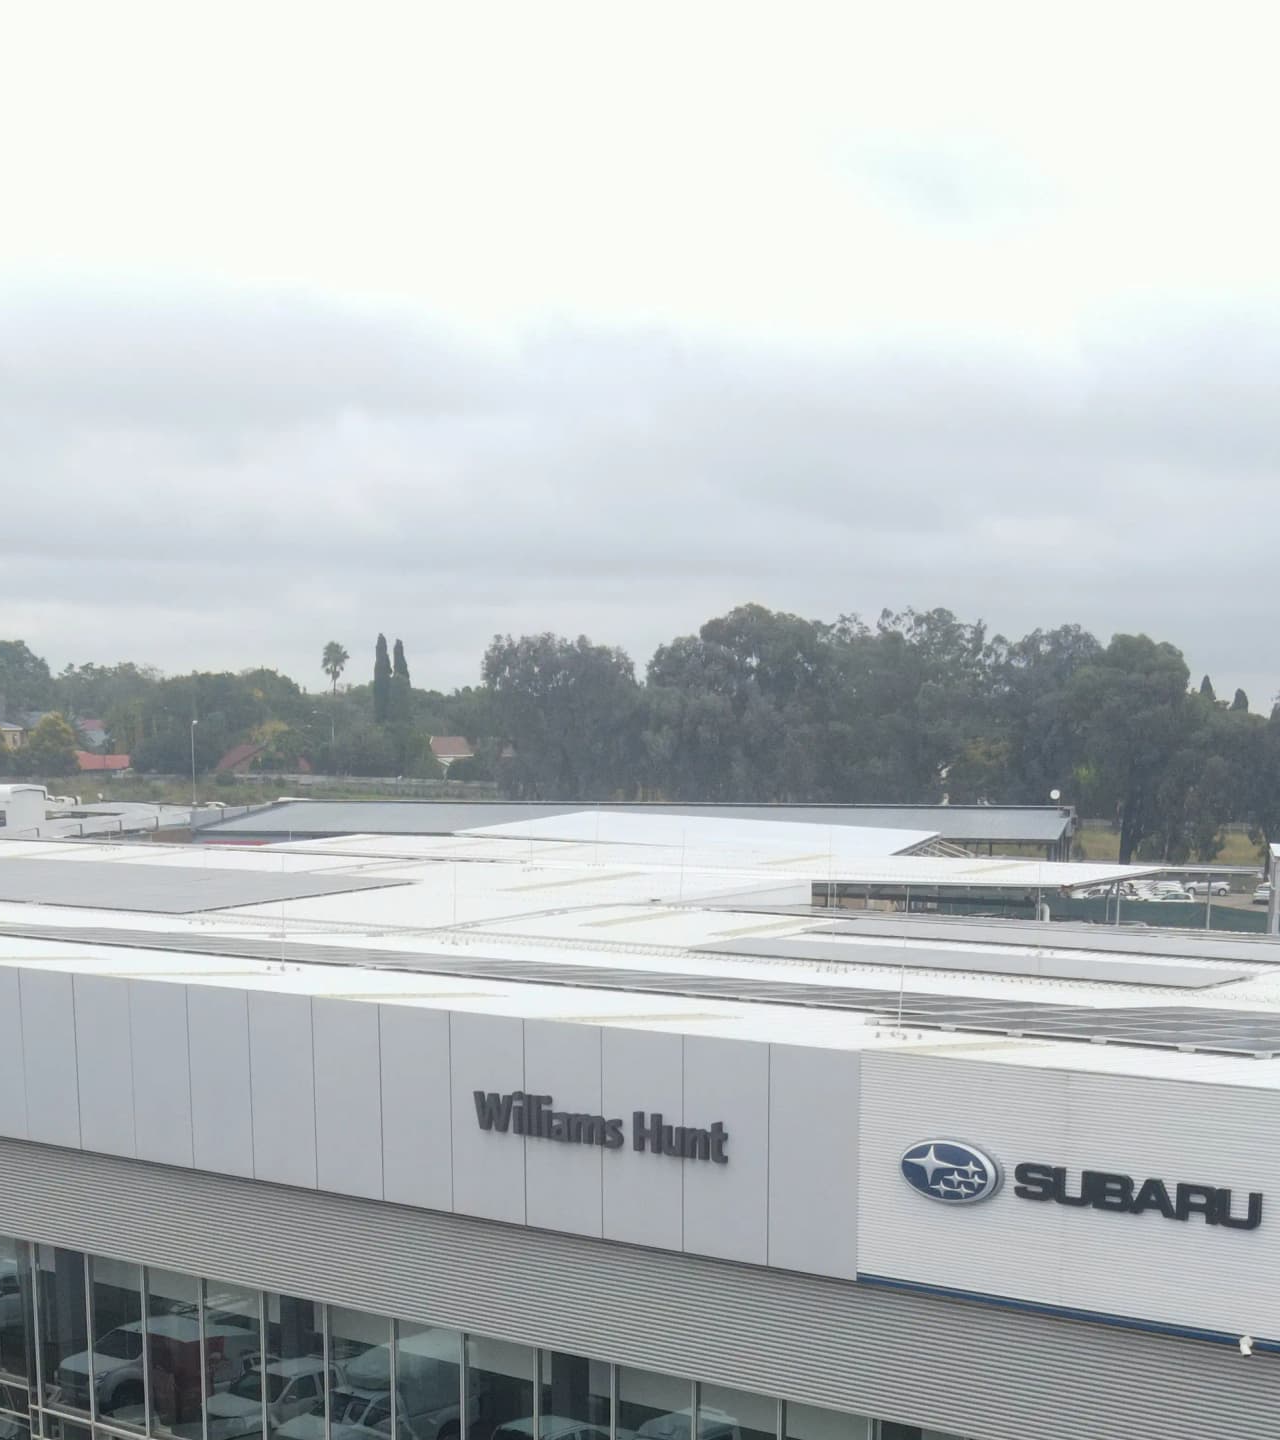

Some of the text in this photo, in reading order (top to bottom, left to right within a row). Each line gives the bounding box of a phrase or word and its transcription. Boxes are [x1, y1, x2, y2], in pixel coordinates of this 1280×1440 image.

[473, 1090, 730, 1164] Williams Hunt
[1014, 1161, 1264, 1231] SUBARU
